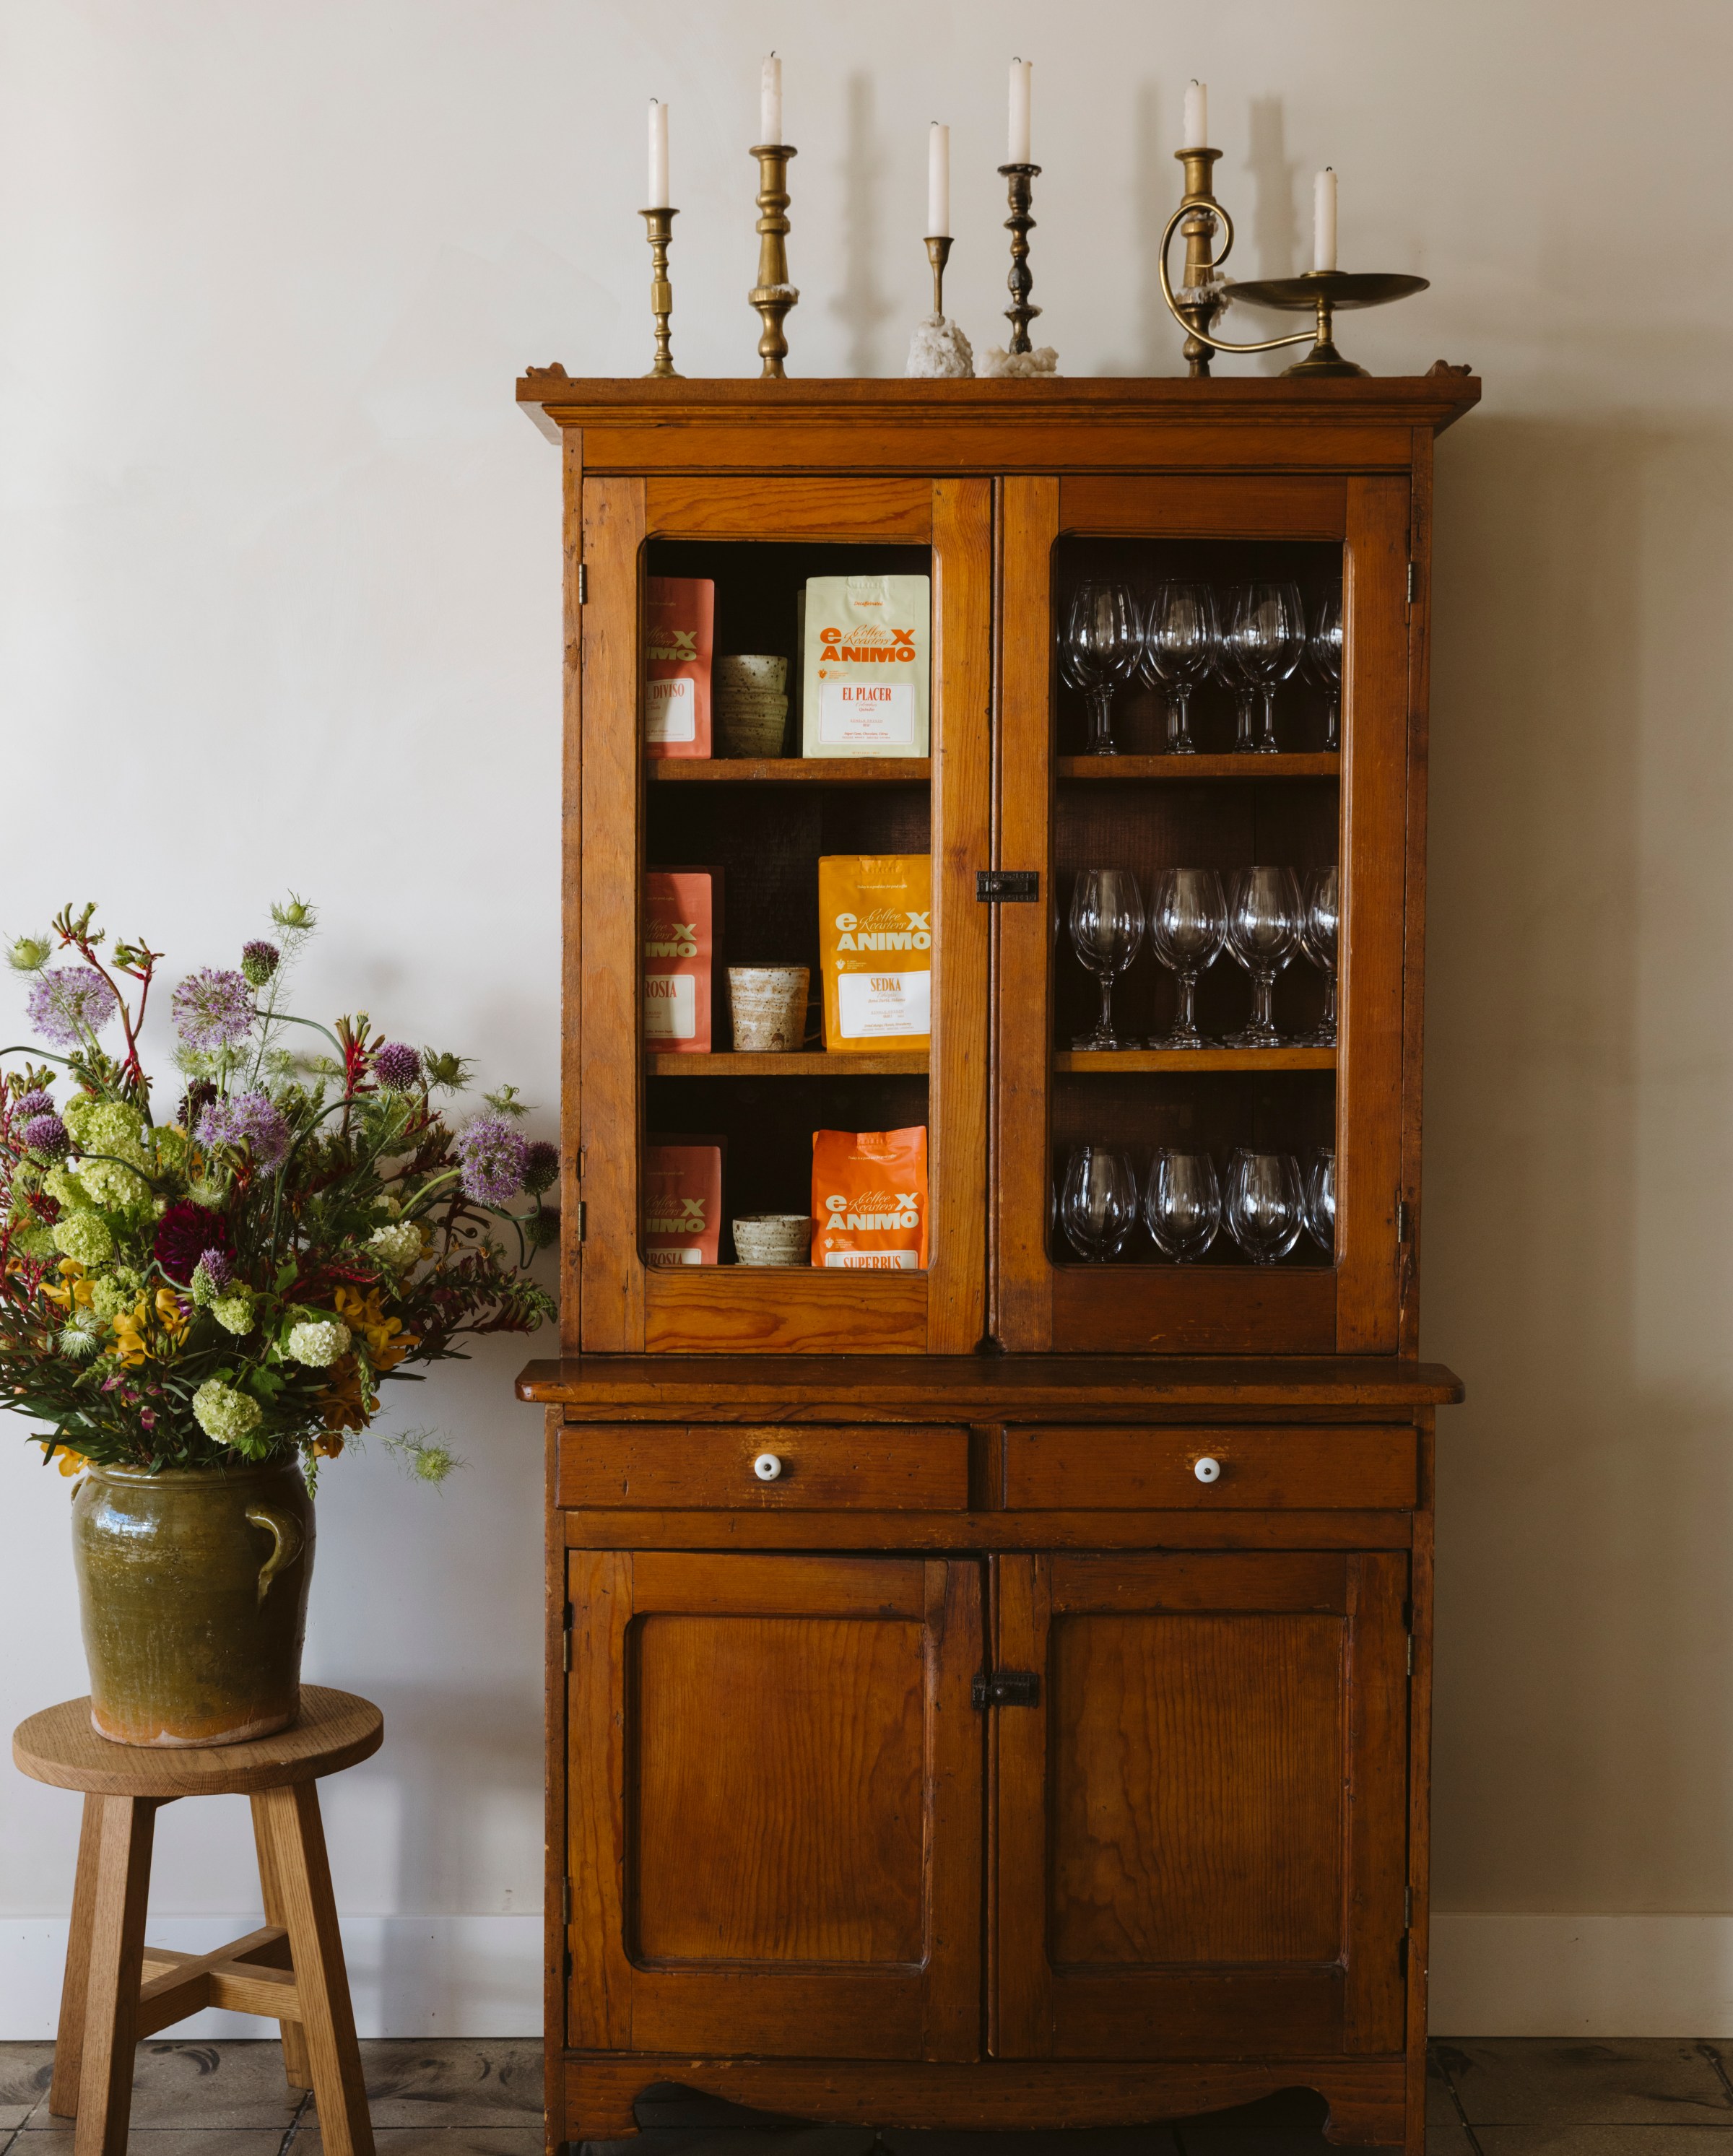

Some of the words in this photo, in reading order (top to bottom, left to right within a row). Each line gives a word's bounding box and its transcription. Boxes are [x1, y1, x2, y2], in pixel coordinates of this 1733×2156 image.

[843, 630, 892, 646] Roasters
[853, 624, 887, 638] Coffee
[820, 646, 916, 662] ANIMO
[653, 683, 685, 699] DIVISO
[843, 687, 854, 701] EL
[856, 687, 892, 701] PLACER
[869, 908, 901, 922] Coffee
[859, 916, 906, 932] Roasters
[836, 931, 931, 951] ANIMO
[870, 978, 902, 991] SEDKA
[859, 1191, 891, 1204] Coffee
[848, 1199, 895, 1213] Roasters
[825, 1211, 919, 1230] ANIMO
[843, 1256, 901, 1269] SUPERBUS
